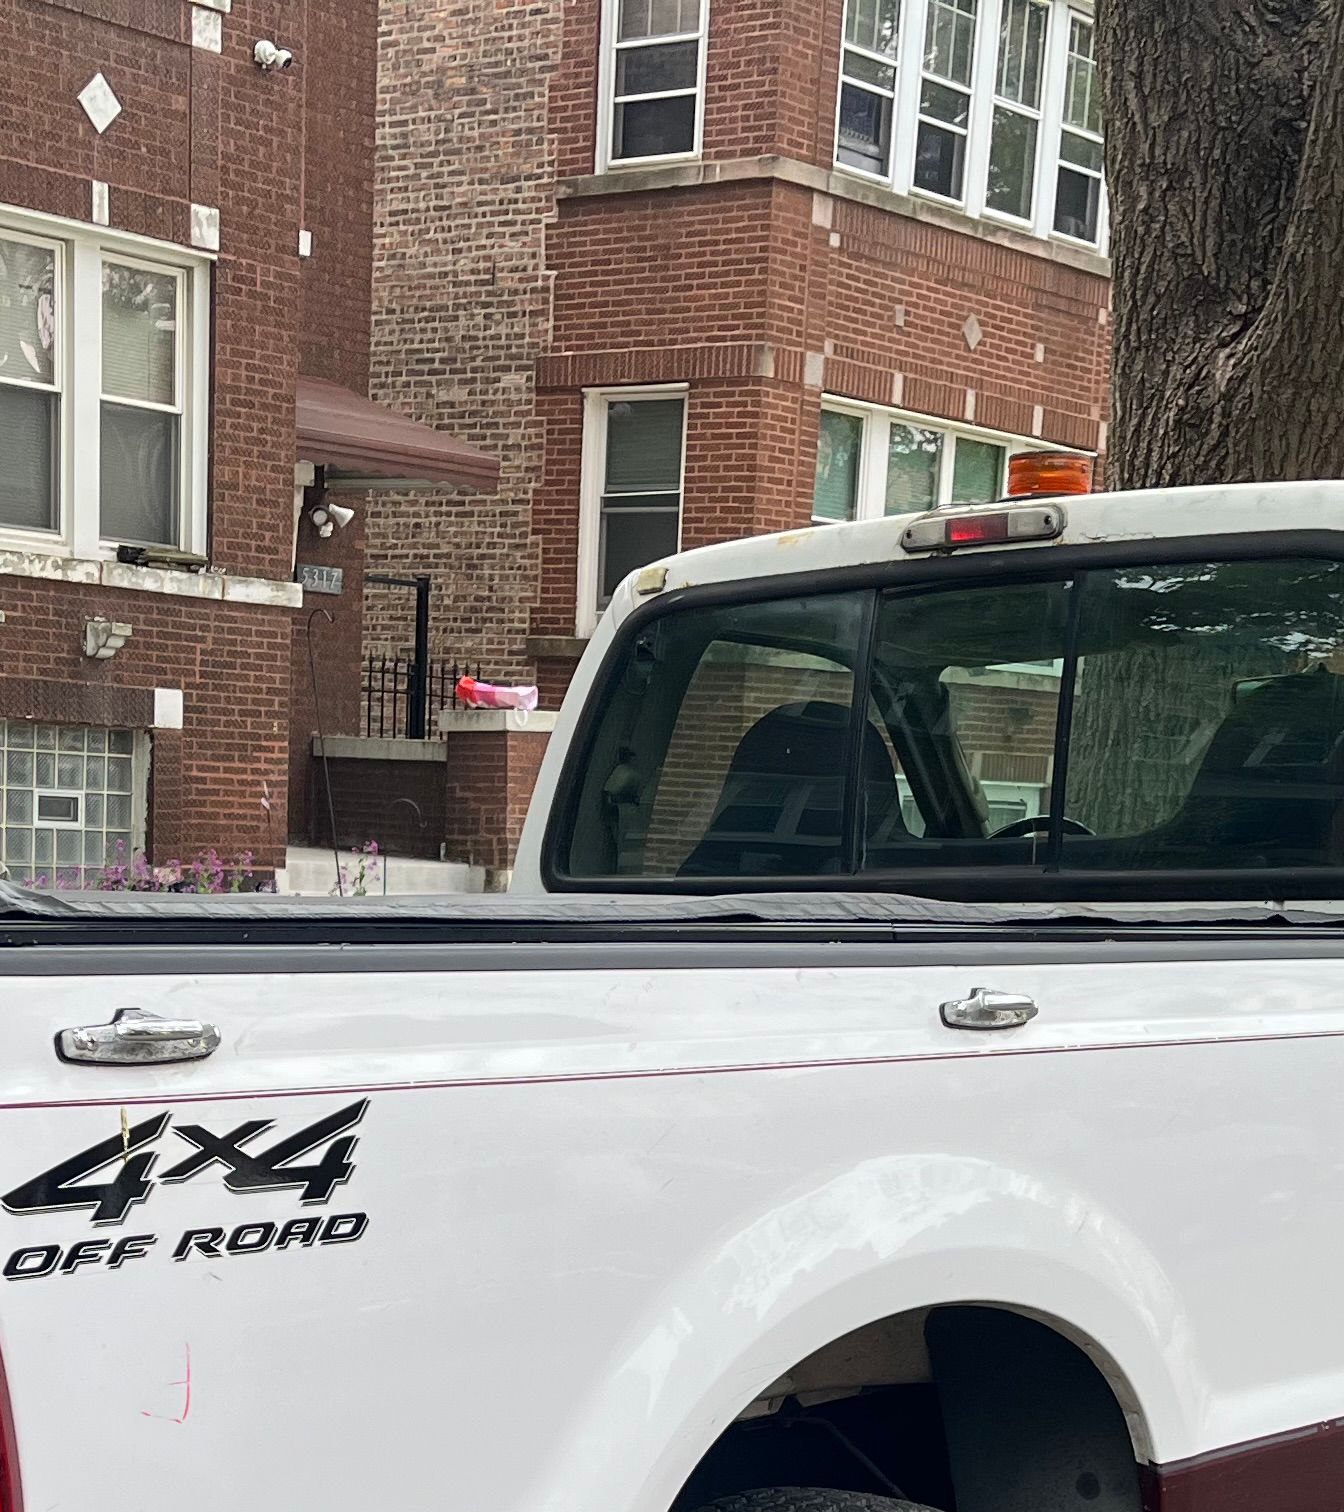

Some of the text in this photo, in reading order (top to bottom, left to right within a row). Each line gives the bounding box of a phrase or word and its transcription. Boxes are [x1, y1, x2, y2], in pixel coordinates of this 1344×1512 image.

[302, 568, 338, 588] 5317
[2, 1211, 368, 1281] OFF ROAD
